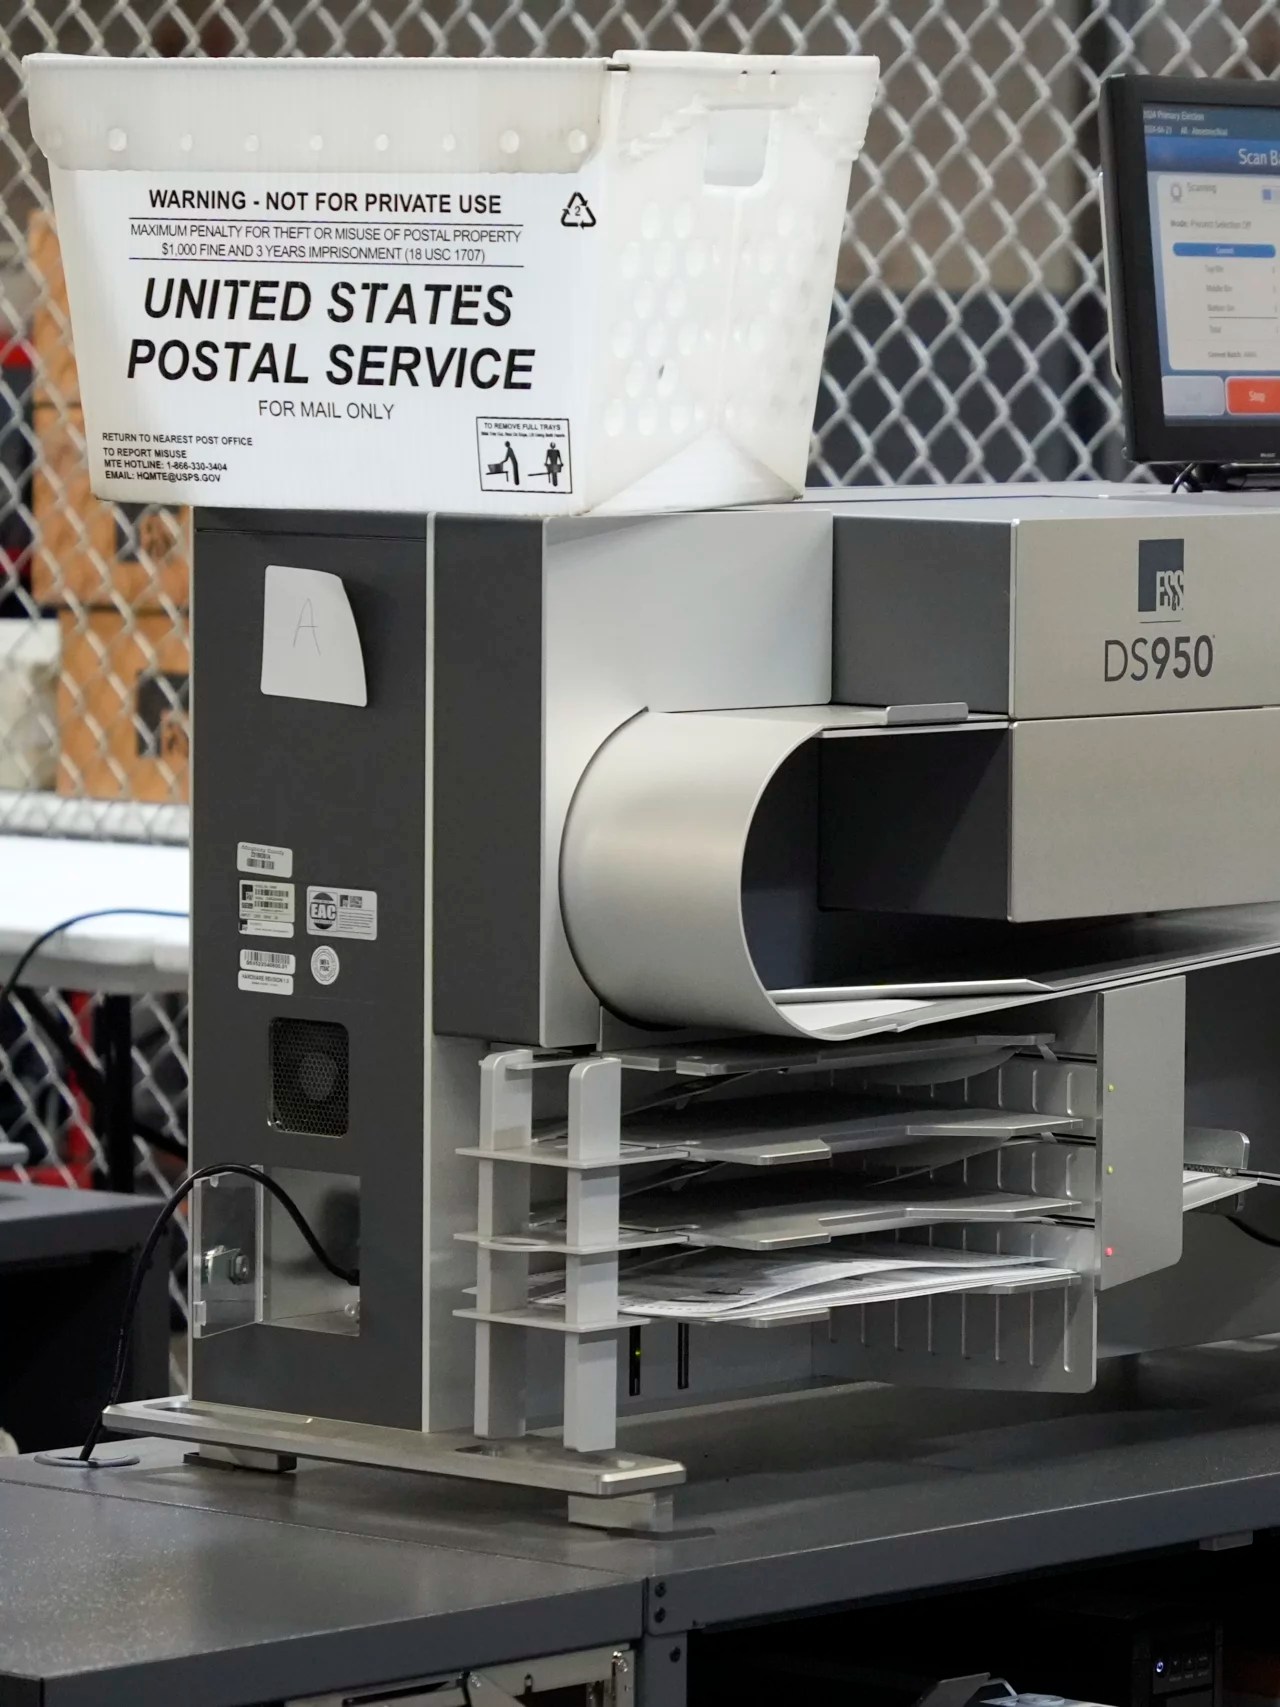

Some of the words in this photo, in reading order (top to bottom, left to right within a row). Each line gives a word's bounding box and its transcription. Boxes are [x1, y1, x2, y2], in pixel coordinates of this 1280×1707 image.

[1238, 149, 1267, 166] Scan
[149, 189, 246, 210] WARNING
[266, 191, 309, 211] NOT
[316, 192, 358, 212] FOR
[365, 193, 451, 213] PRIVATE
[459, 194, 501, 214] USE
[574, 205, 581, 216] 2
[131, 224, 187, 237] MAXIMUM
[190, 225, 242, 238] PENALTY
[245, 226, 270, 238] FOR
[273, 226, 311, 239] THEFT
[314, 227, 332, 240] OR
[335, 228, 381, 241] MISUSE
[384, 228, 401, 241] OF
[404, 228, 451, 242] POSTAL
[453, 229, 521, 242] PROPERTY
[162, 242, 197, 256] $1,000
[200, 243, 226, 256] FINE
[228, 244, 253, 257] AND
[256, 245, 263, 257] 3
[265, 245, 306, 258] YEARS
[309, 246, 402, 260] IMPRISONMENT
[405, 248, 422, 262] (18
[425, 248, 451, 261] USC
[455, 249, 485, 263] 1707)
[144, 277, 311, 321] UNITED
[327, 281, 513, 327] STATES
[127, 339, 309, 384] POSTAL
[326, 344, 536, 390] SERVICE
[259, 400, 295, 417] FOR
[301, 401, 342, 418] MAIL
[347, 402, 394, 420] ONLY
[102, 432, 137, 442] RETURN
[140, 434, 151, 443] TO
[153, 434, 193, 444] NEAREST
[196, 436, 219, 445] POST
[221, 436, 253, 446] OFFICE
[103, 447, 115, 456] TO
[117, 448, 152, 457] REPORT
[154, 449, 187, 459] MISUSE
[104, 459, 122, 468] MTE
[293, 597, 322, 657] A
[1104, 634, 1214, 682] DS950
[310, 902, 337, 921] EAC
